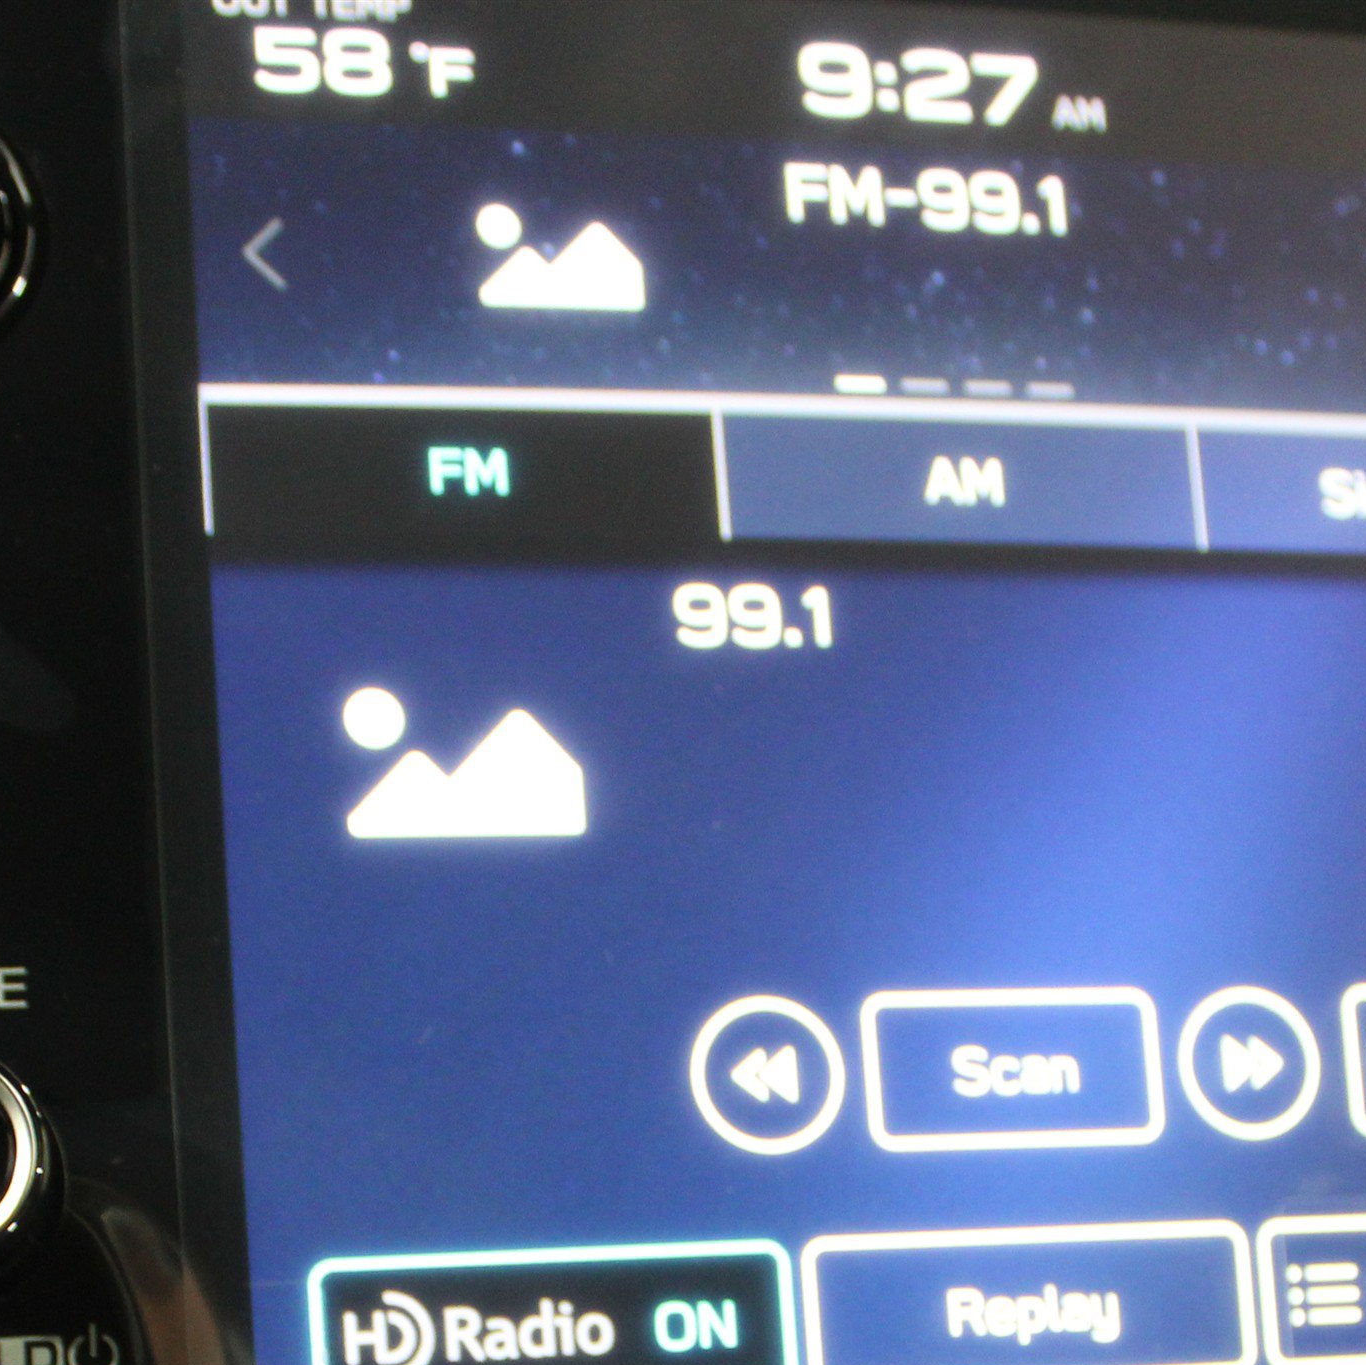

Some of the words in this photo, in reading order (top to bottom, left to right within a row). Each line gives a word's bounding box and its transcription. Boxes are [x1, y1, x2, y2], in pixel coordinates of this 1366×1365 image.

[253, 25, 393, 97] 58
[797, 42, 1039, 126] 9:27
[1051, 95, 1107, 132] AM
[783, 161, 1068, 236] FM-99.1
[428, 447, 511, 496] FM
[924, 457, 1006, 507] AM
[672, 582, 833, 650] 99.1
[950, 1044, 1081, 1097] Scan
[443, 1298, 615, 1362] Radio
[654, 1299, 738, 1352] ON
[946, 1286, 1122, 1346] Replay
